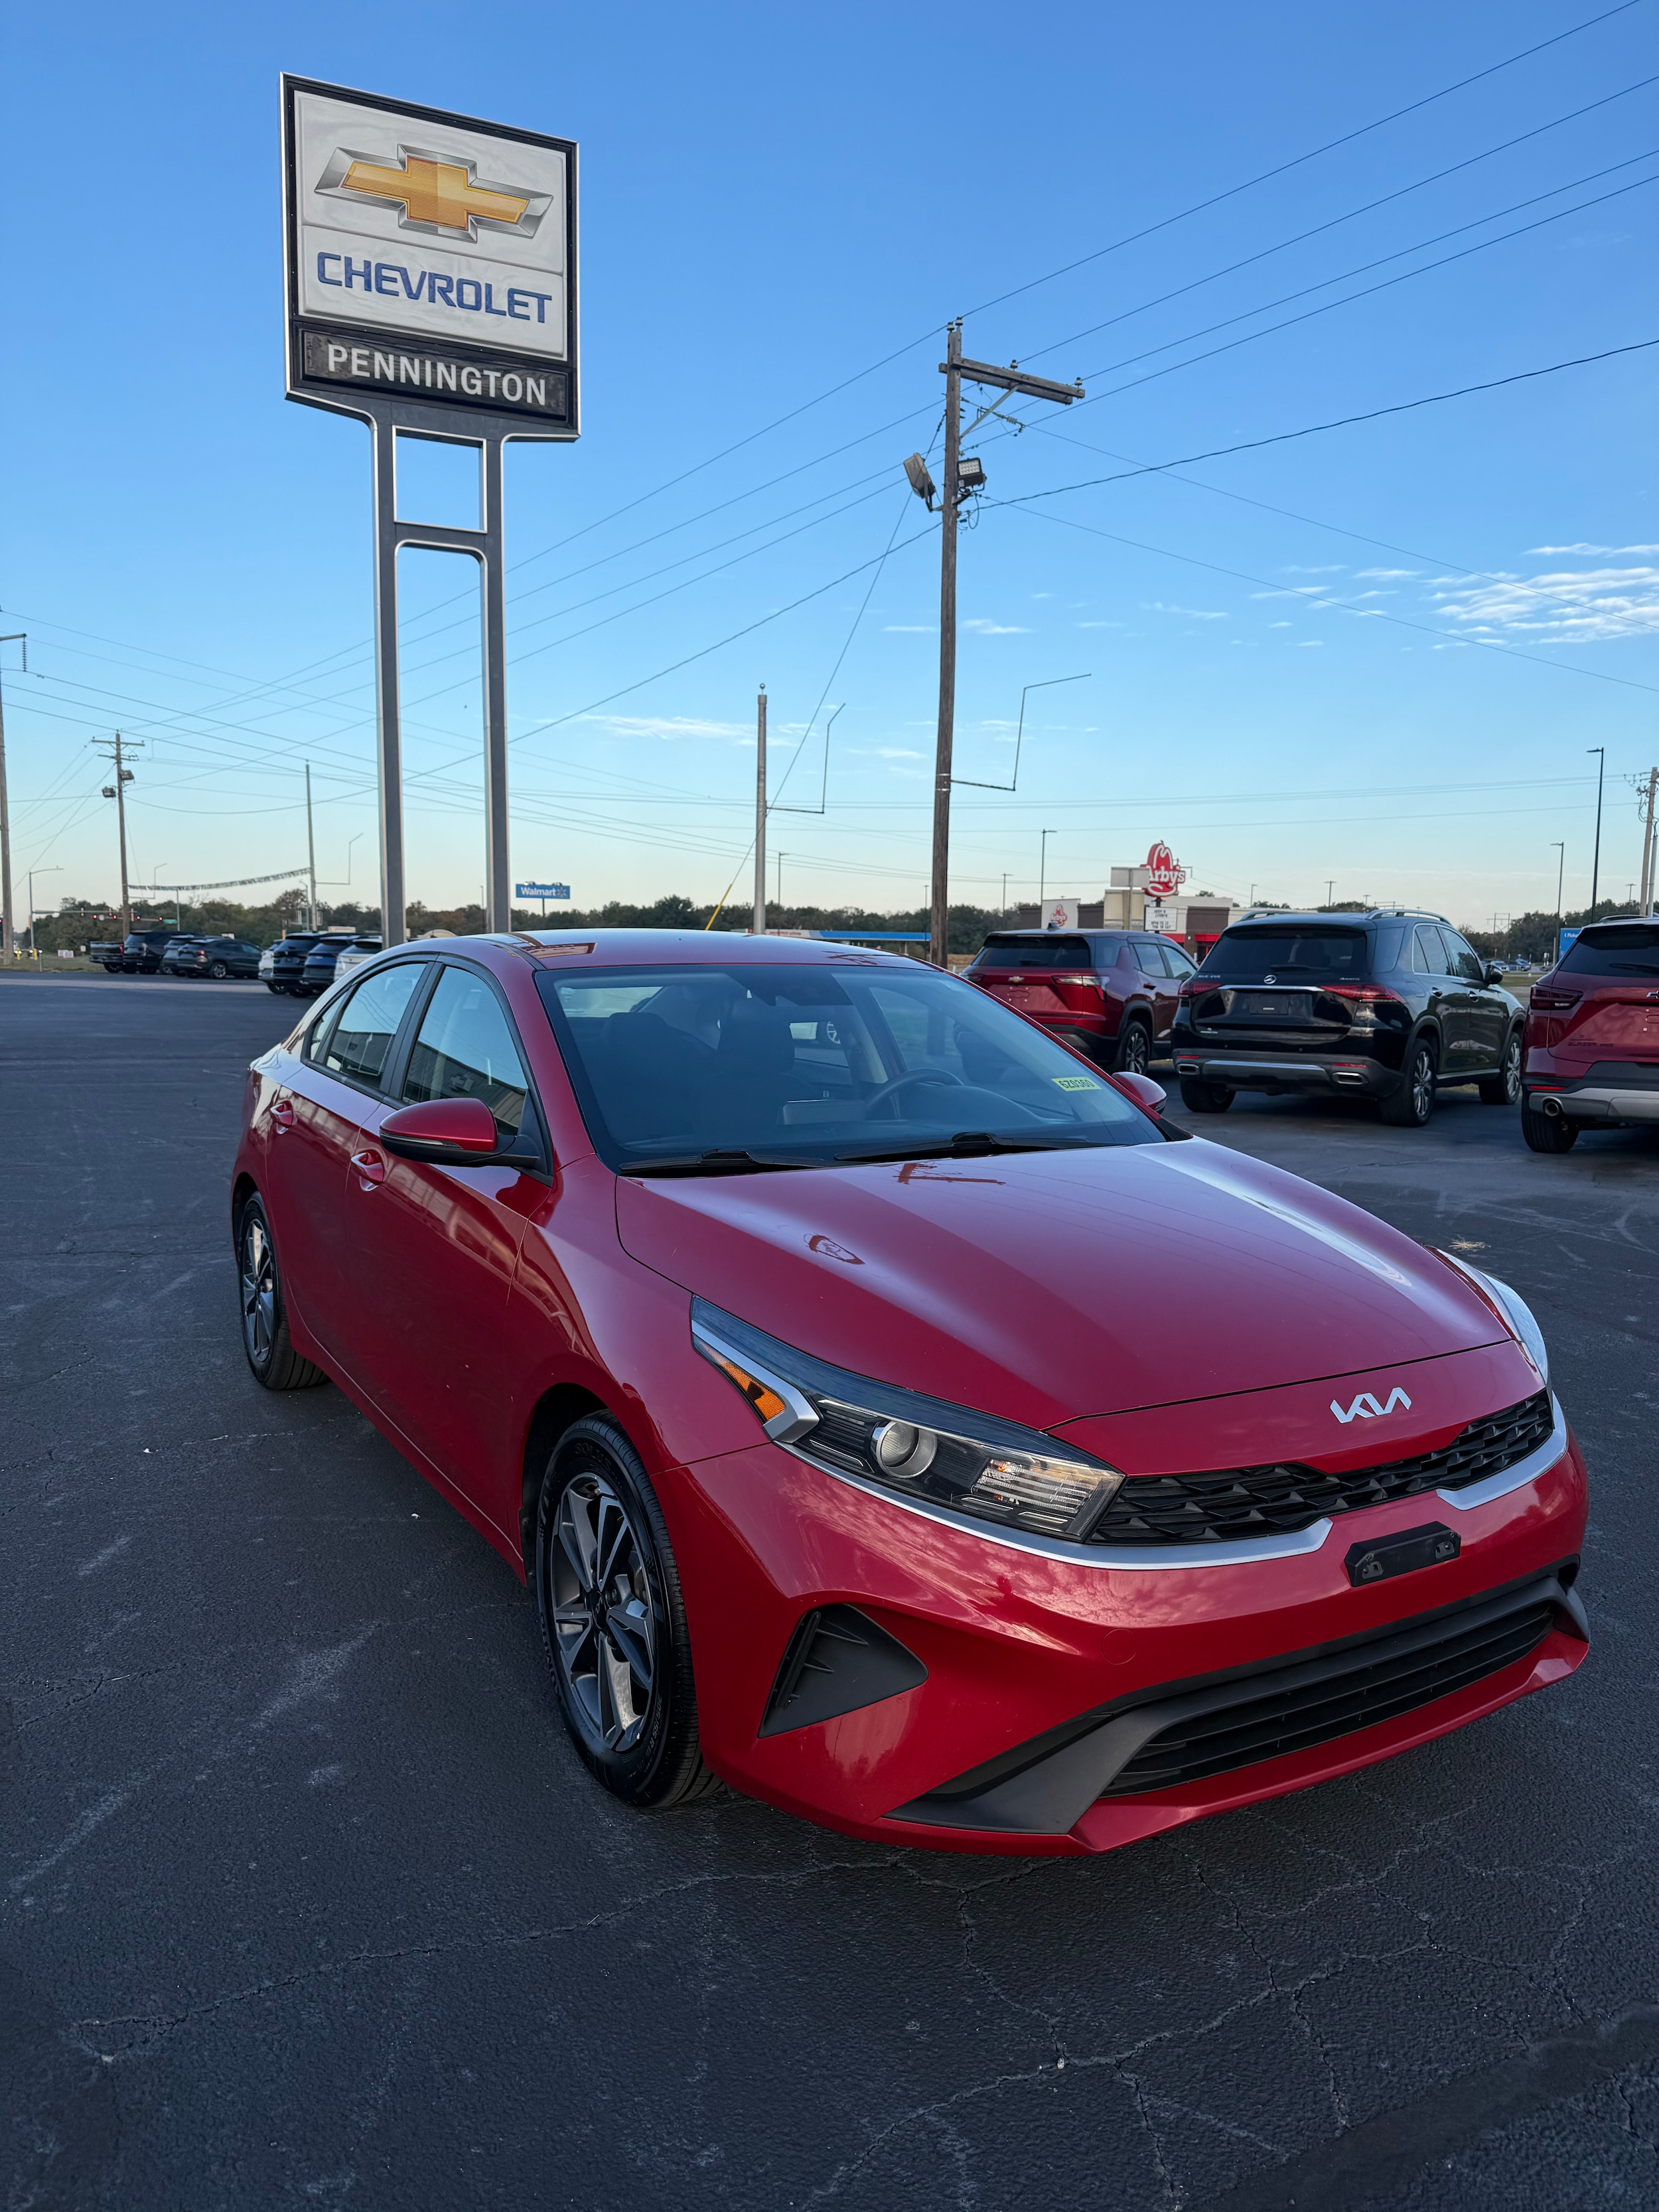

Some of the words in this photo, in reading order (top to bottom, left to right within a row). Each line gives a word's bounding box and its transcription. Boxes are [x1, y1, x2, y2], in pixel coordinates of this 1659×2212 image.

[318, 252, 552, 323] CHEVROLET
[328, 344, 545, 406] PENNINGTON
[520, 887, 556, 896] Walmart
[1330, 1386, 1412, 1424] KIA
[575, 1442, 611, 1471] SOLUS
